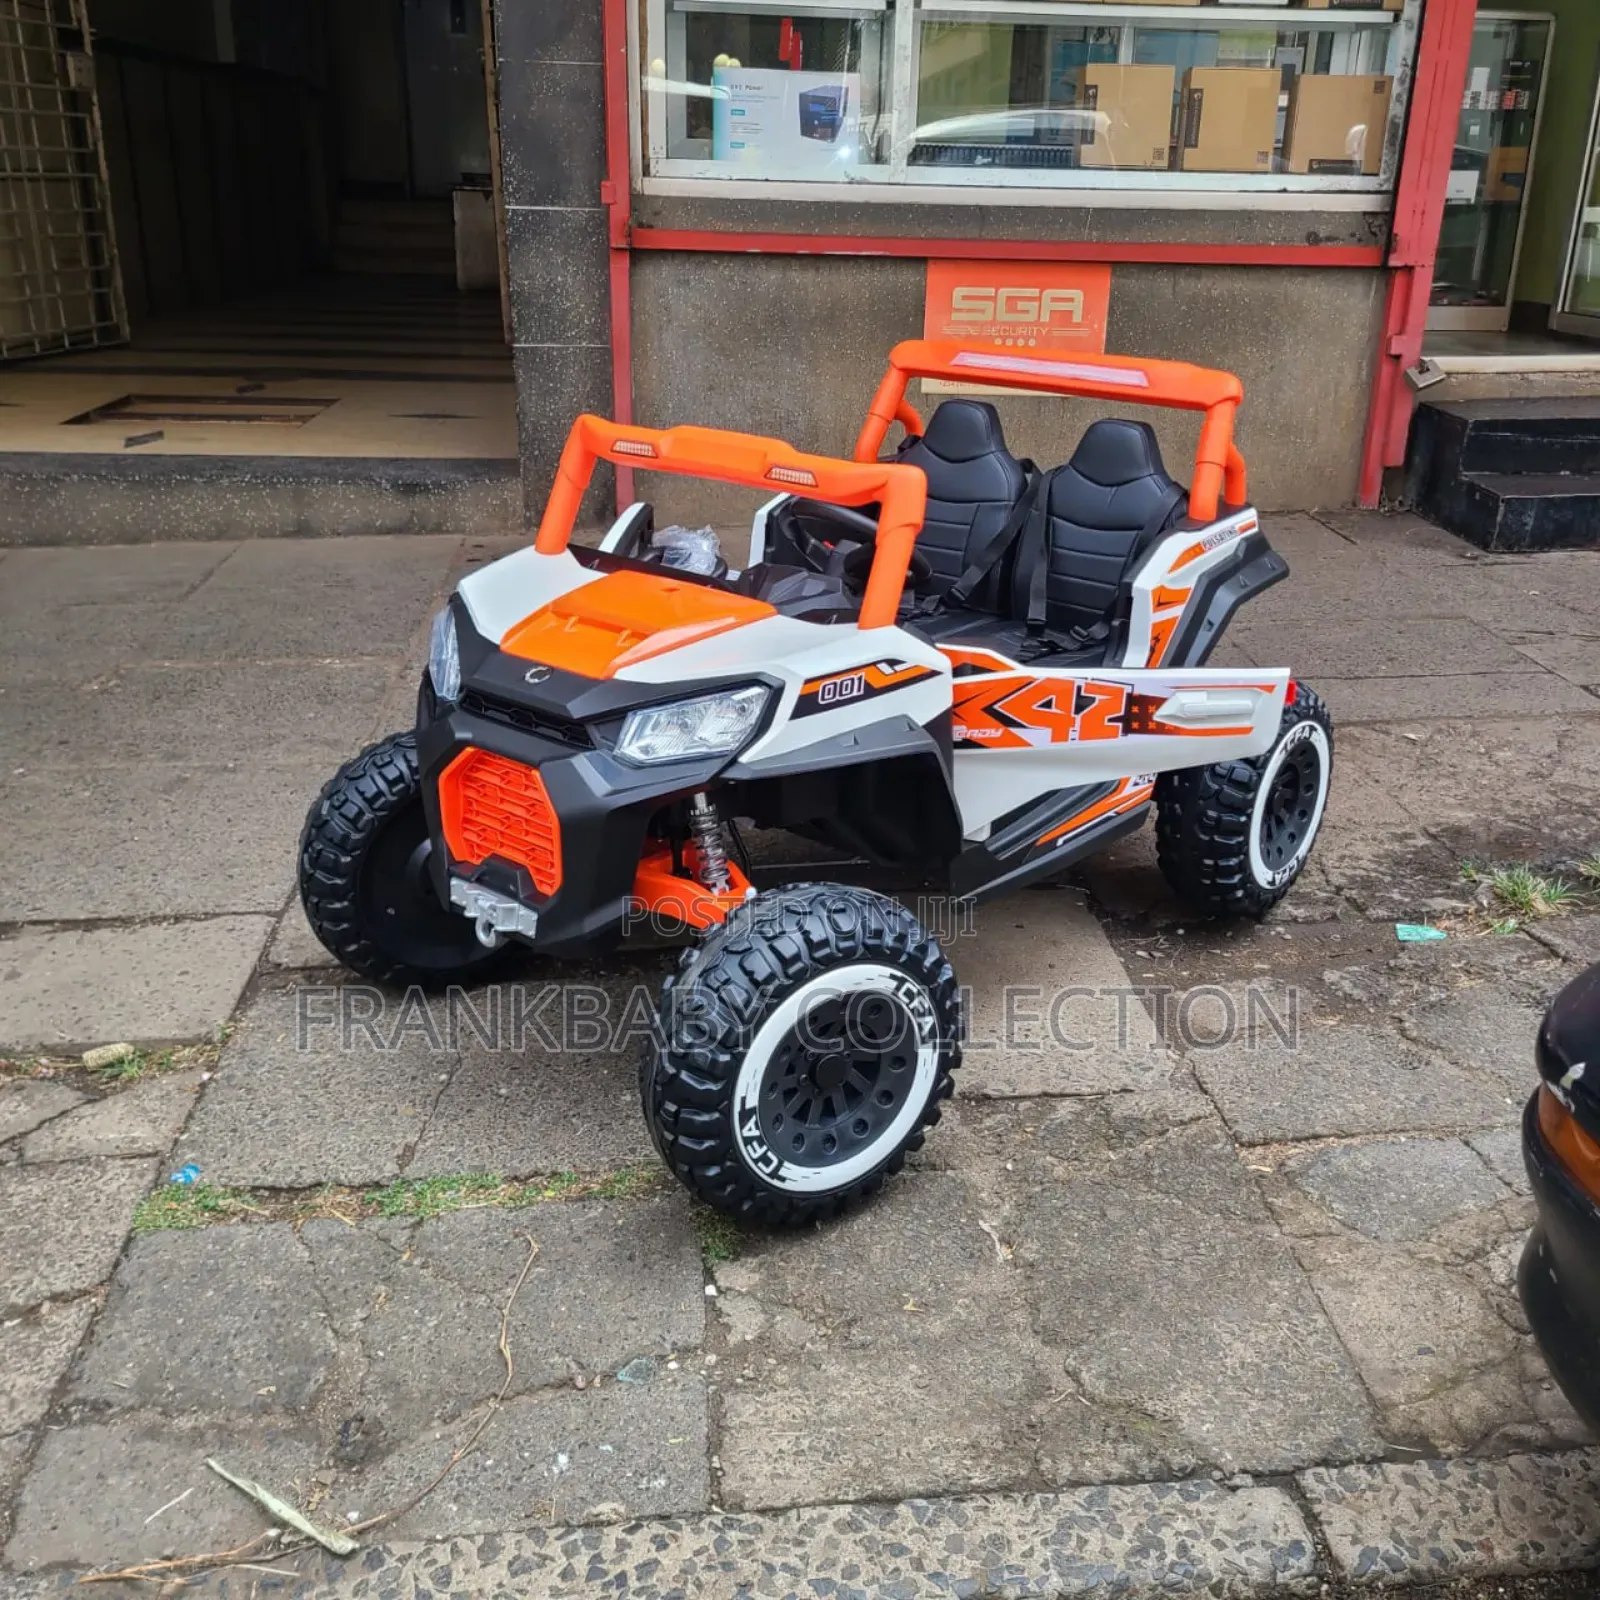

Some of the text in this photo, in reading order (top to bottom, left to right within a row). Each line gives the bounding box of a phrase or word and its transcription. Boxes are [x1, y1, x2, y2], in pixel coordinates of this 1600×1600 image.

[951, 286, 1085, 323] SGA
[981, 325, 1049, 337] SECURITY
[818, 673, 865, 704] 001
[995, 676, 1127, 744] 42
